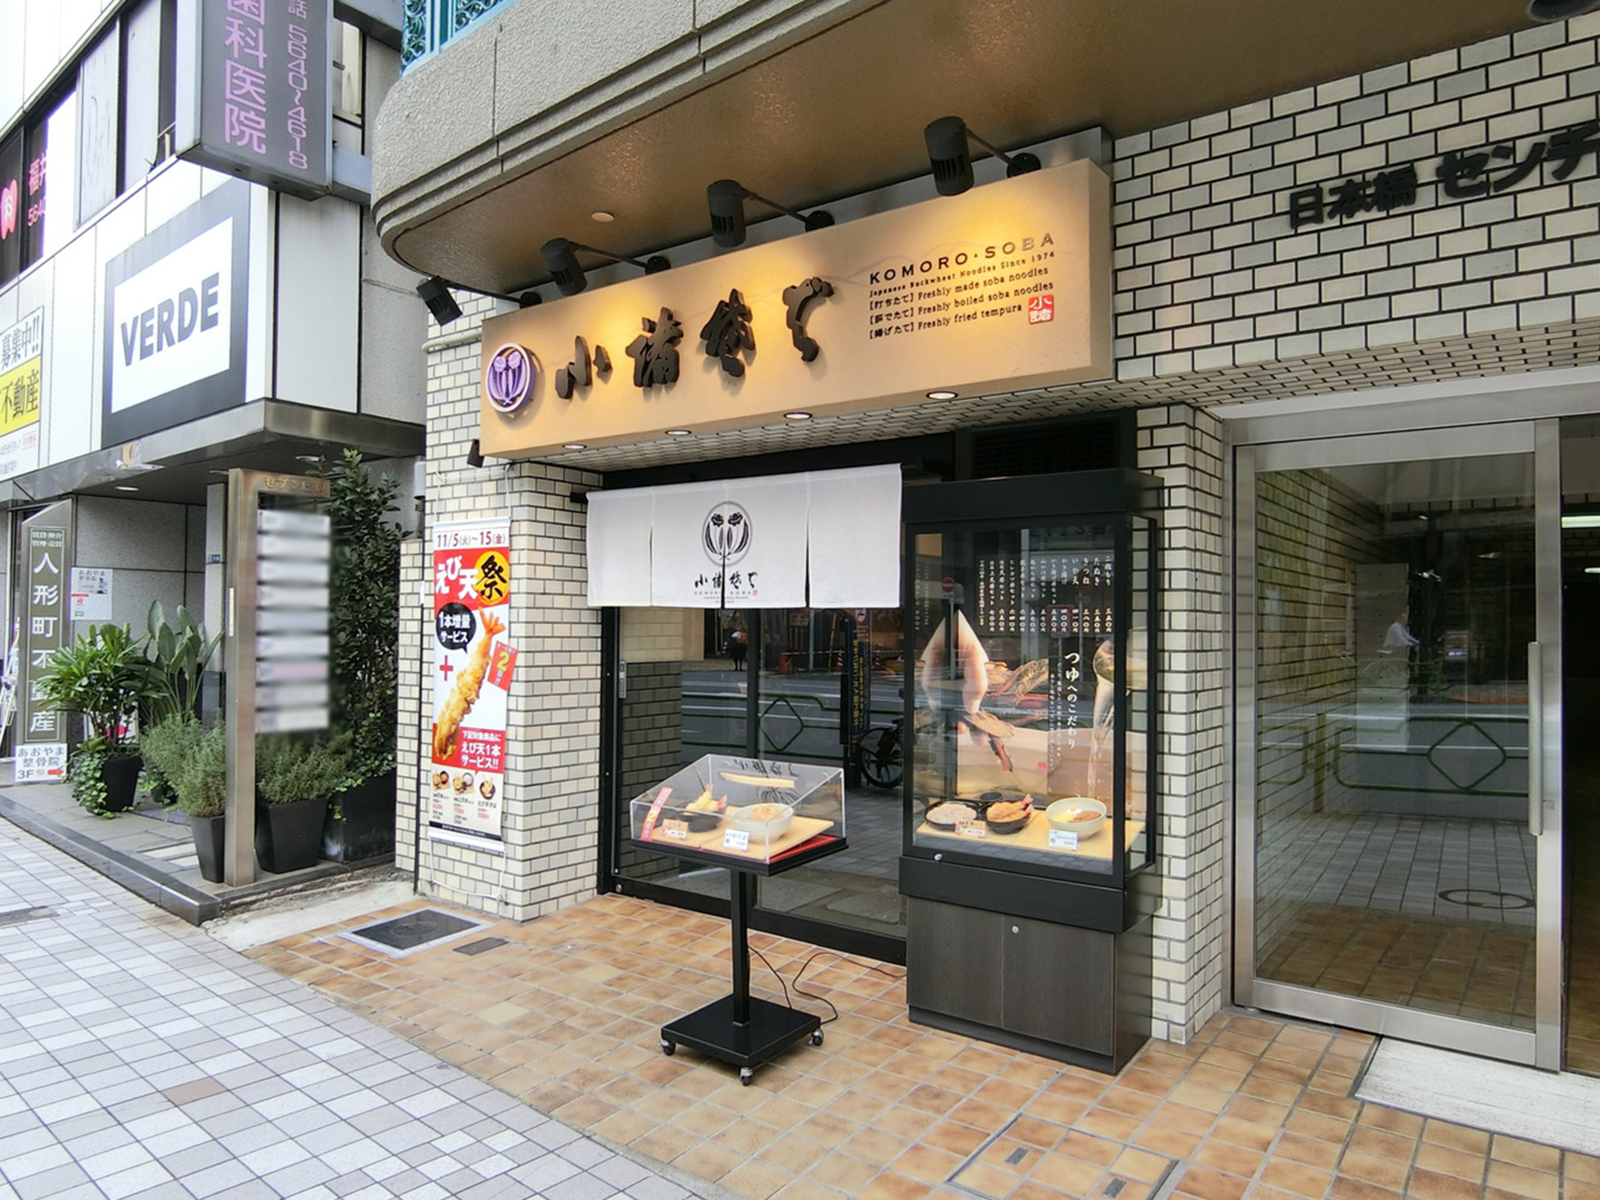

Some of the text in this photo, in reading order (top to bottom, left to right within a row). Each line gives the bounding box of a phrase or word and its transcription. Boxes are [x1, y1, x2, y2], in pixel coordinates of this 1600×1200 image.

[869, 250, 1055, 298] Japanese Buckwheat Noodles Since 1974
[918, 286, 951, 301] Freshly
[954, 281, 980, 293] made
[983, 275, 1005, 287] soba
[1009, 265, 1049, 282] noodles
[918, 301, 951, 316] Freshly
[954, 294, 984, 308] boiled
[988, 289, 1010, 301] soba
[1013, 280, 1054, 297] noodles
[120, 271, 220, 367] VERDE
[918, 316, 951, 331] Freshly
[954, 310, 978, 324] fried
[981, 304, 1023, 319] tempura
[440, 631, 468, 643] サービス
[1065, 651, 1080, 750] つゆへのこだわり
[18, 746, 65, 758] あおやま
[461, 742, 502, 757] えび天1本
[17, 769, 34, 779] 3F
